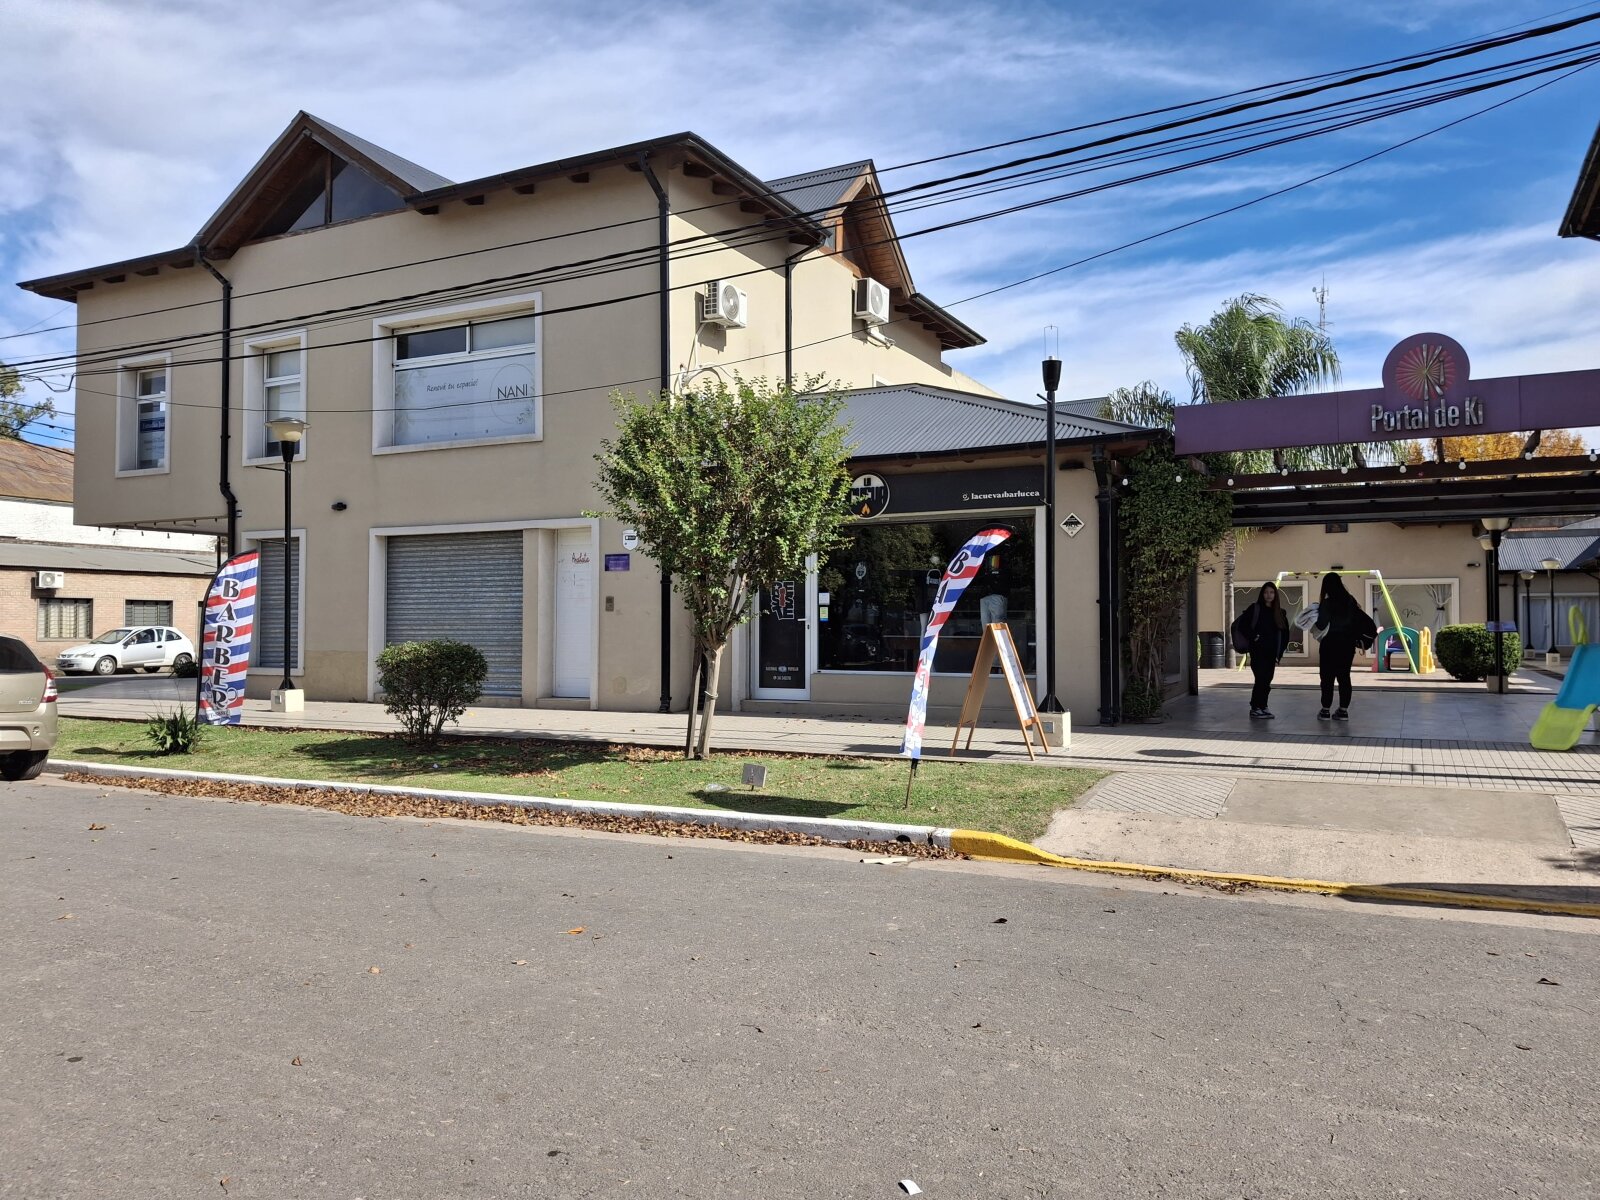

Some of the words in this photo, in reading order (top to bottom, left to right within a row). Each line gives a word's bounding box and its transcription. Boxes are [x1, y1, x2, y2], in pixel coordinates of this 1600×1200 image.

[497, 383, 528, 399] NANI
[1371, 400, 1430, 432] Portal
[1434, 398, 1460, 428] de
[1464, 396, 1484, 426] Ki
[212, 579, 240, 708] BARBER
